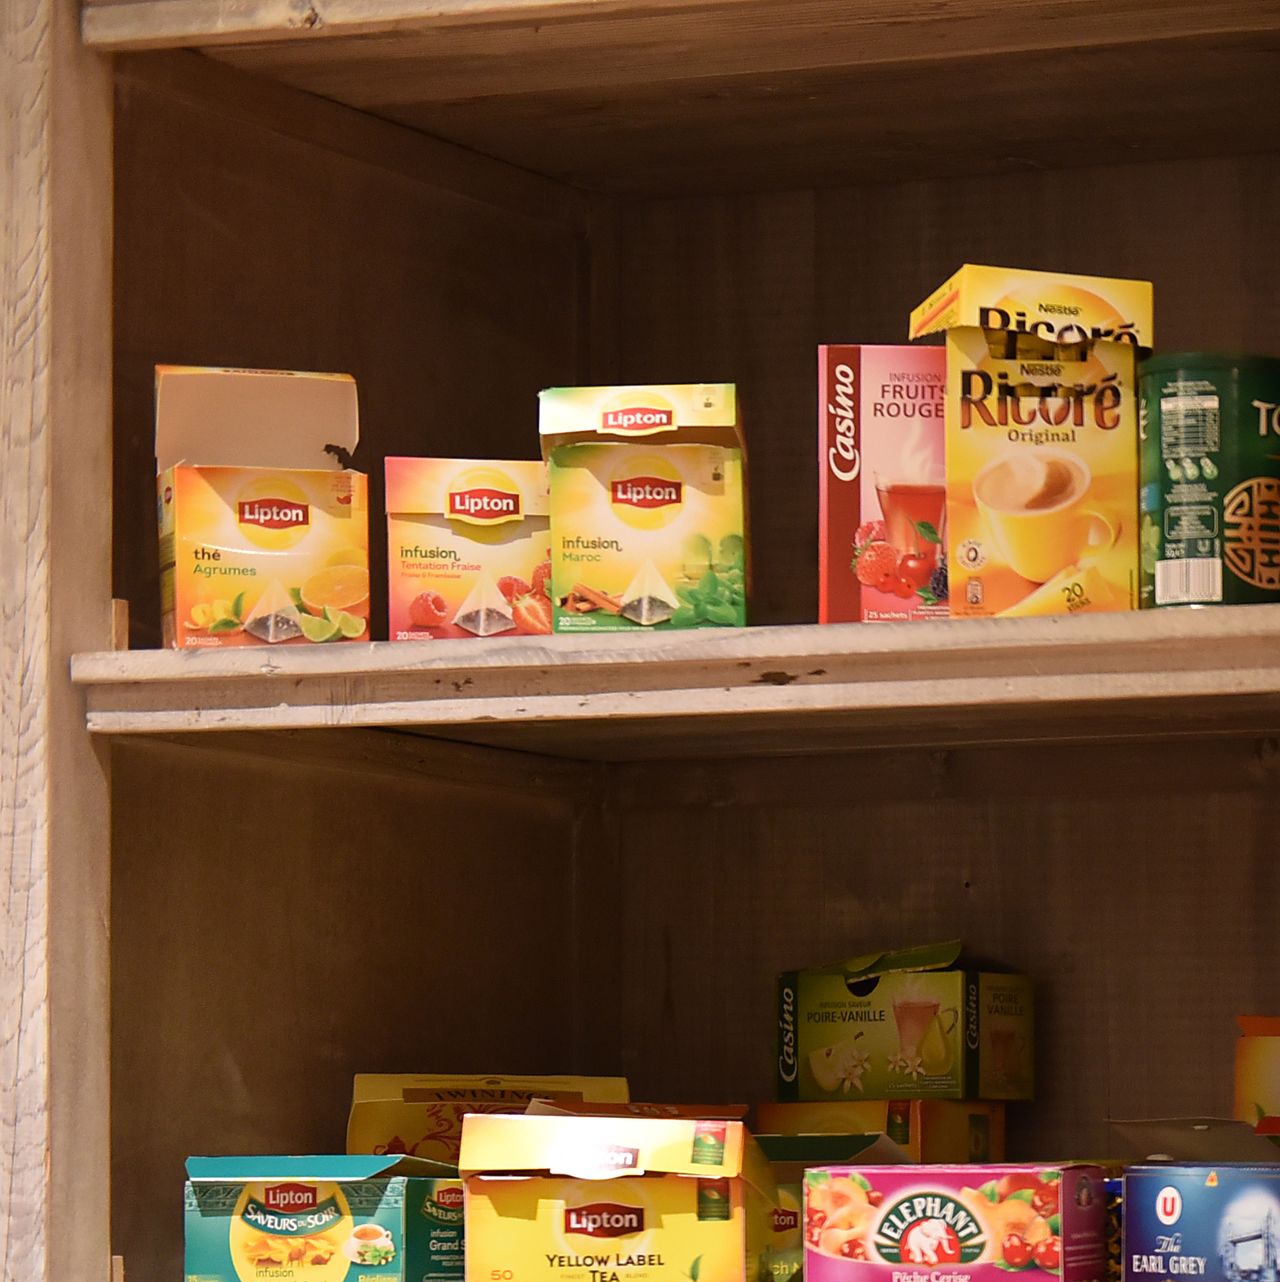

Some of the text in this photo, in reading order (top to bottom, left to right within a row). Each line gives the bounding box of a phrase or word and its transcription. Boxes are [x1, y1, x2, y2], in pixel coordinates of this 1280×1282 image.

[889, 372, 941, 383] INFUSION
[873, 402, 945, 418] ROUGE
[606, 411, 667, 428] Lipton
[828, 363, 862, 482] Casino
[1007, 429, 1077, 445] Original
[617, 482, 677, 502] Lipton
[454, 494, 515, 513] Lipton
[243, 504, 304, 522] Lipton
[562, 536, 622, 552] infusion
[194, 547, 221, 561] thé
[400, 546, 461, 562] infusion
[562, 552, 601, 562] Maroc
[193, 563, 257, 577] Agrumes
[401, 560, 481, 571] Tentation Fraise
[1061, 580, 1084, 603] 20
[807, 1009, 886, 1024] POIRE-VANILLE
[779, 987, 799, 1083] Casino
[268, 1187, 313, 1208] Lipton
[439, 1191, 464, 1204] Lipto
[1161, 1196, 1176, 1218] U
[245, 1204, 297, 1231] SAVEURS
[307, 1206, 339, 1229] SOIR
[570, 1212, 638, 1232] Lipton
[880, 1196, 979, 1240] ELEPHANT
[429, 1239, 459, 1251] Grand
[545, 1253, 665, 1268] YELLOW LABEL
[1132, 1254, 1207, 1274] EARL GREY
[256, 1267, 294, 1278] infusion
[490, 1269, 514, 1281] 50
[589, 1269, 620, 1282] TEA
